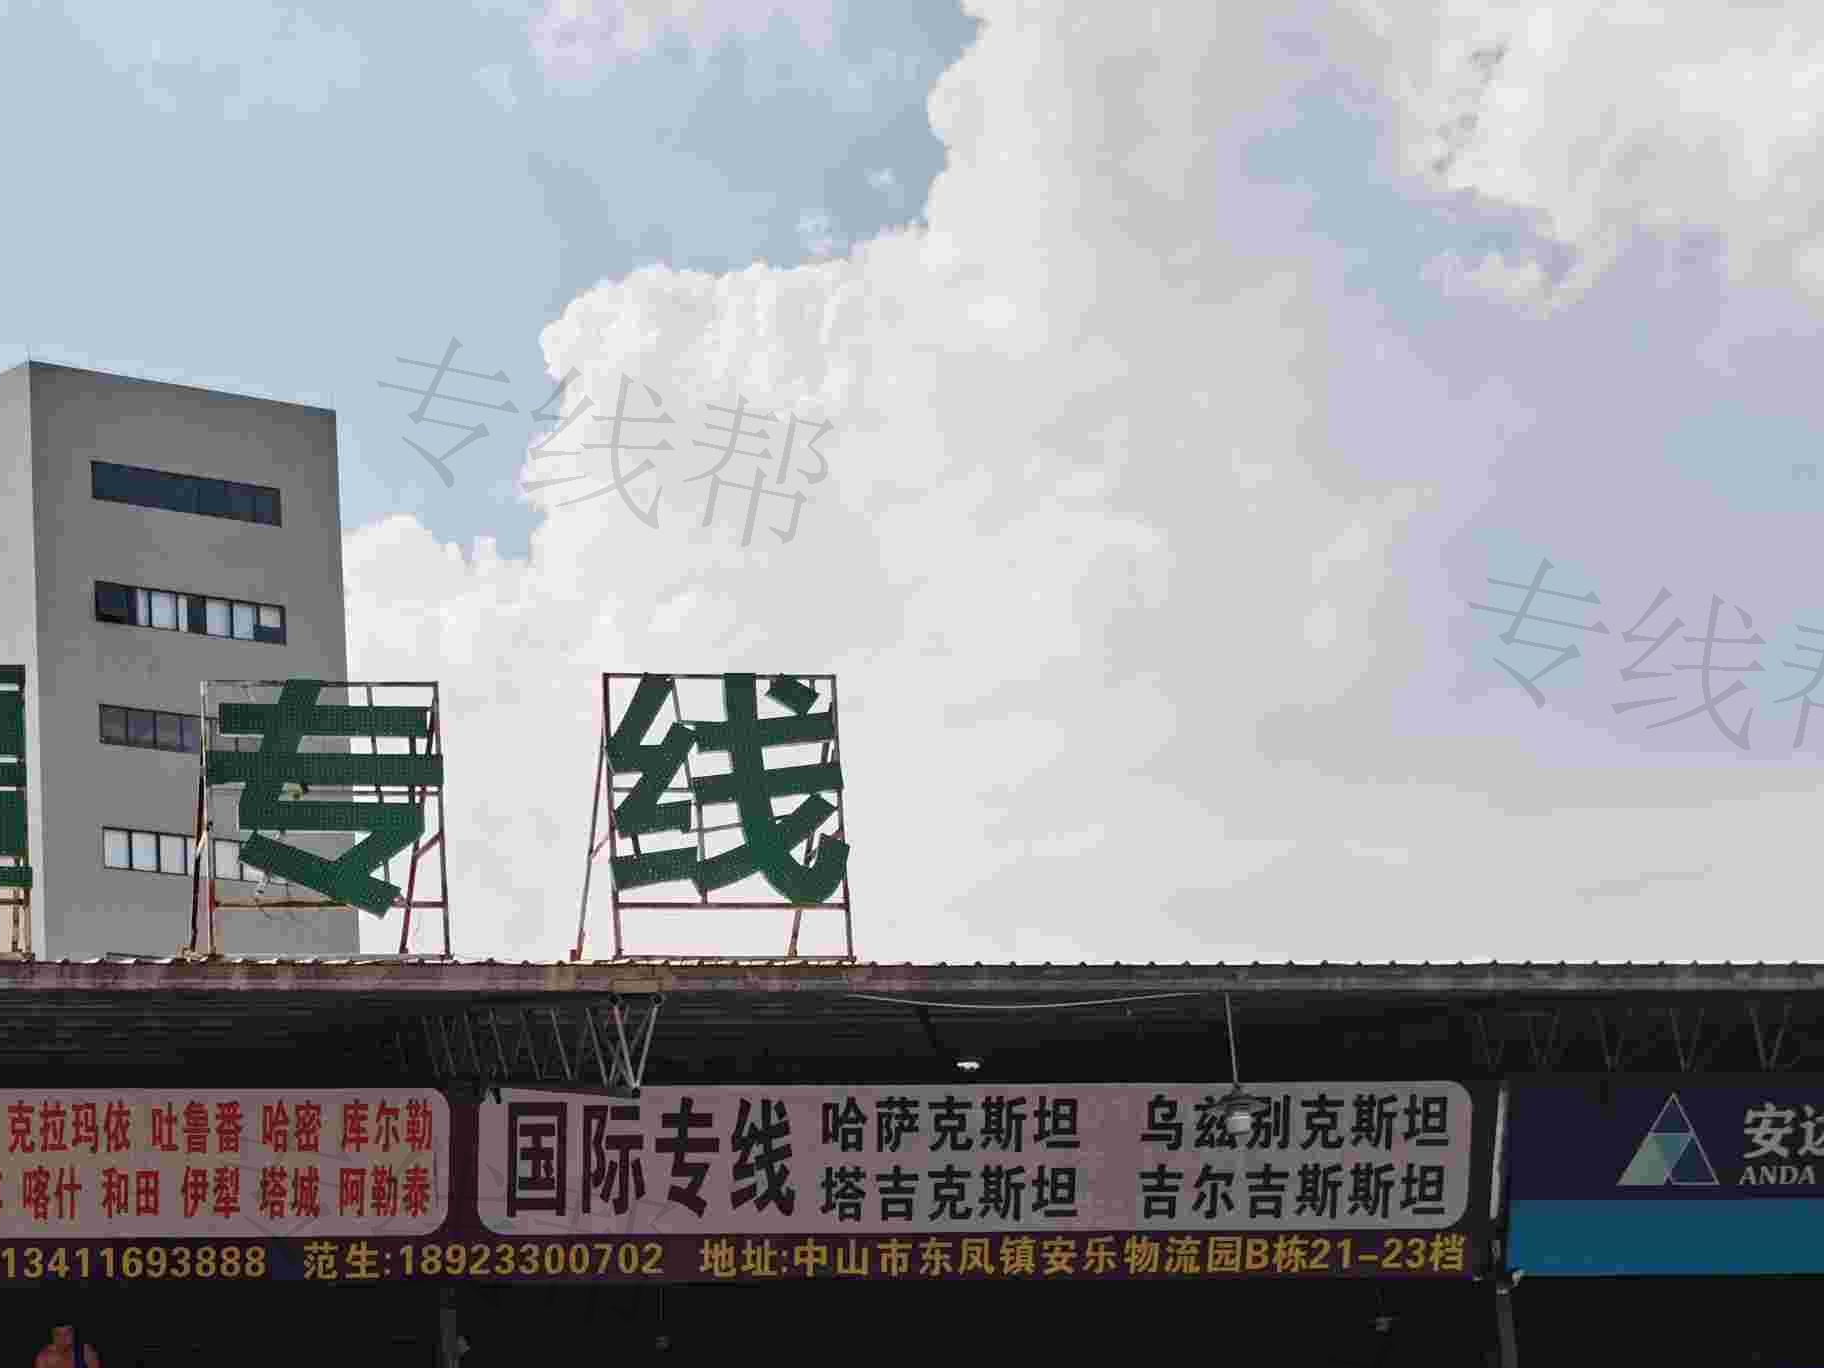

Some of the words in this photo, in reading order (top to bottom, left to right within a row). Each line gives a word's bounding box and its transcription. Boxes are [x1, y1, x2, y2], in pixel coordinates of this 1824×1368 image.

[7, 1101, 131, 1154] 克拉玛依
[150, 1101, 243, 1153] 吐鲁番
[261, 1100, 322, 1153] 哈密
[340, 1100, 434, 1153] 库尔勒
[820, 1095, 1081, 1153] 哈萨克斯坦
[1139, 1092, 1449, 1151] 乌兹别克斯坦
[506, 1097, 796, 1218] 国际专线
[1737, 1165, 1817, 1185] ANDA
[22, 1167, 83, 1221] 喀什
[101, 1166, 161, 1218] 和田
[181, 1166, 241, 1219] 伊犁
[258, 1166, 321, 1219] 塔城
[337, 1166, 431, 1218] 阿勒泰
[820, 1163, 1079, 1222] 塔吉克斯坦
[1138, 1162, 1446, 1220] 吉尔吉斯斯坦
[302, 1240, 663, 1280] 范生:18923300702
